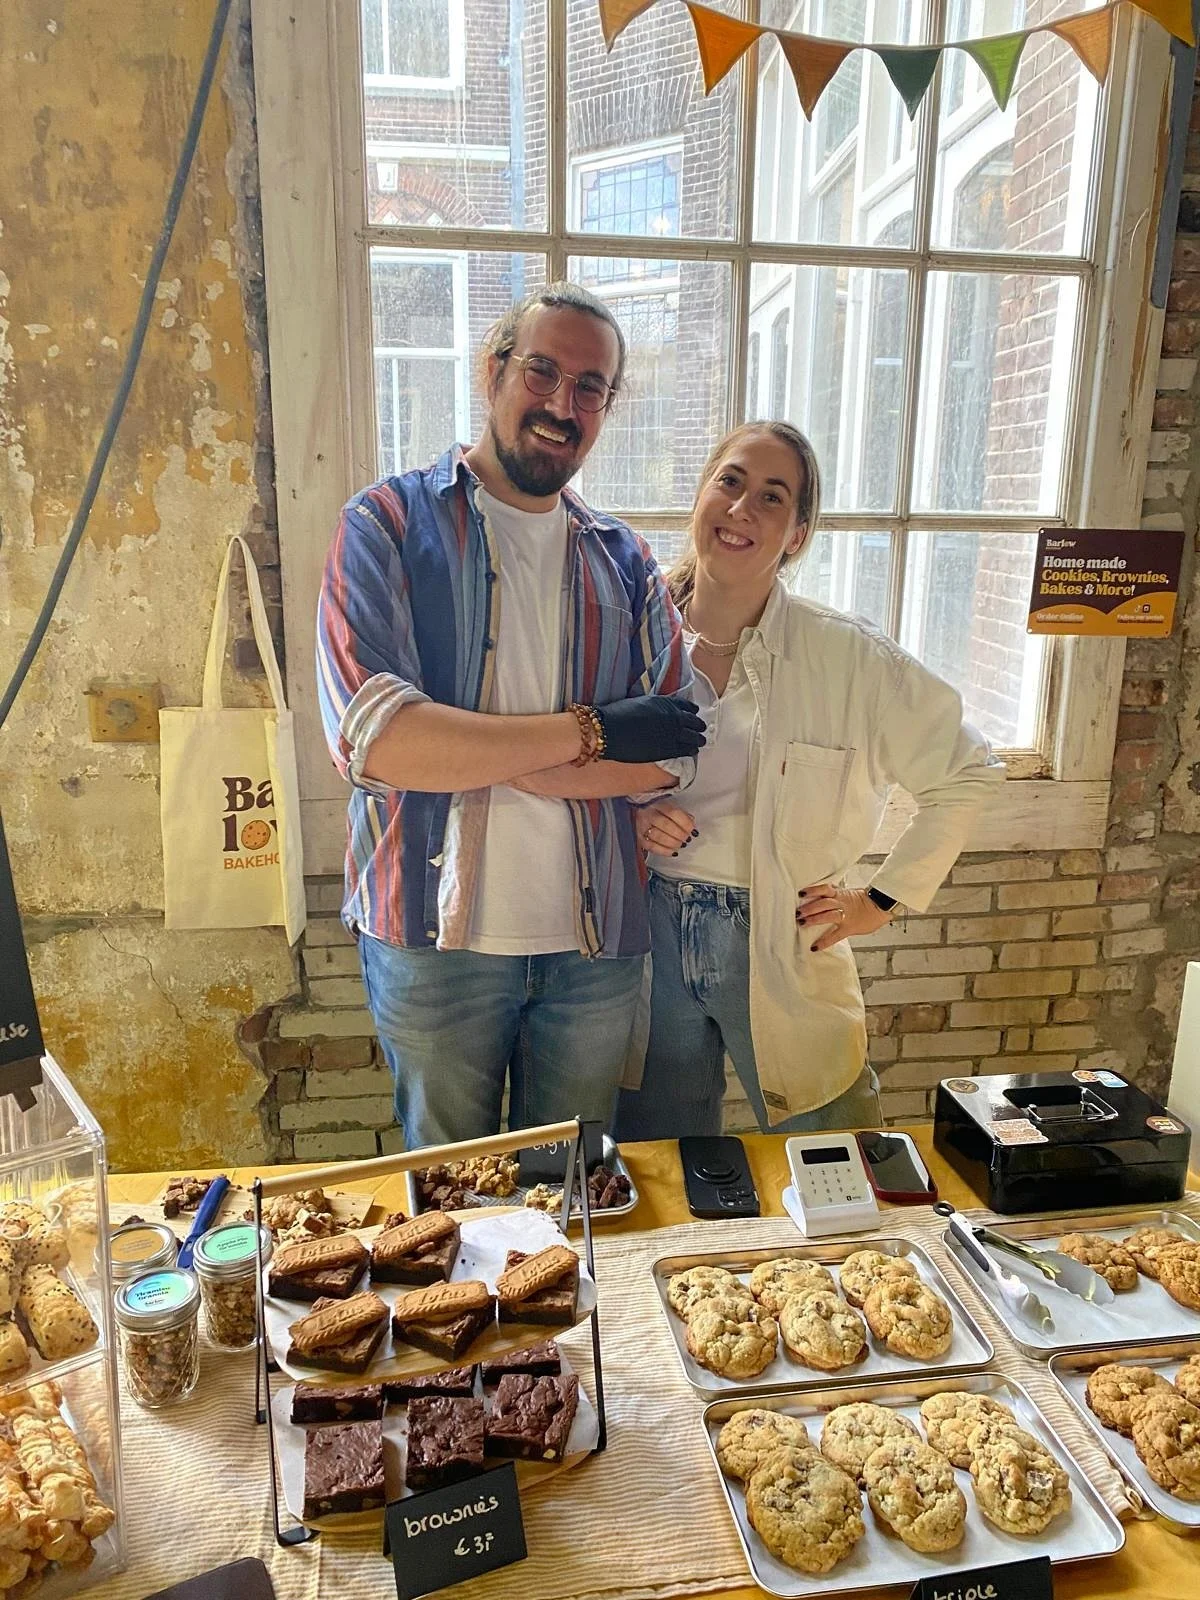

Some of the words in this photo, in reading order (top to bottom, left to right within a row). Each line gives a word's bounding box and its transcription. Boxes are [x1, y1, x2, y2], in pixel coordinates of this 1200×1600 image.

[1042, 555, 1085, 568] Home
[1086, 556, 1127, 569] made
[1041, 569, 1100, 583] Cookies,
[1101, 570, 1169, 584] Brownies,
[1040, 582, 1082, 595] Bakes
[1084, 583, 1095, 595] &
[1095, 583, 1136, 596] More!
[418, 1287, 467, 1306] Lotus
[404, 1496, 499, 1538] brownies
